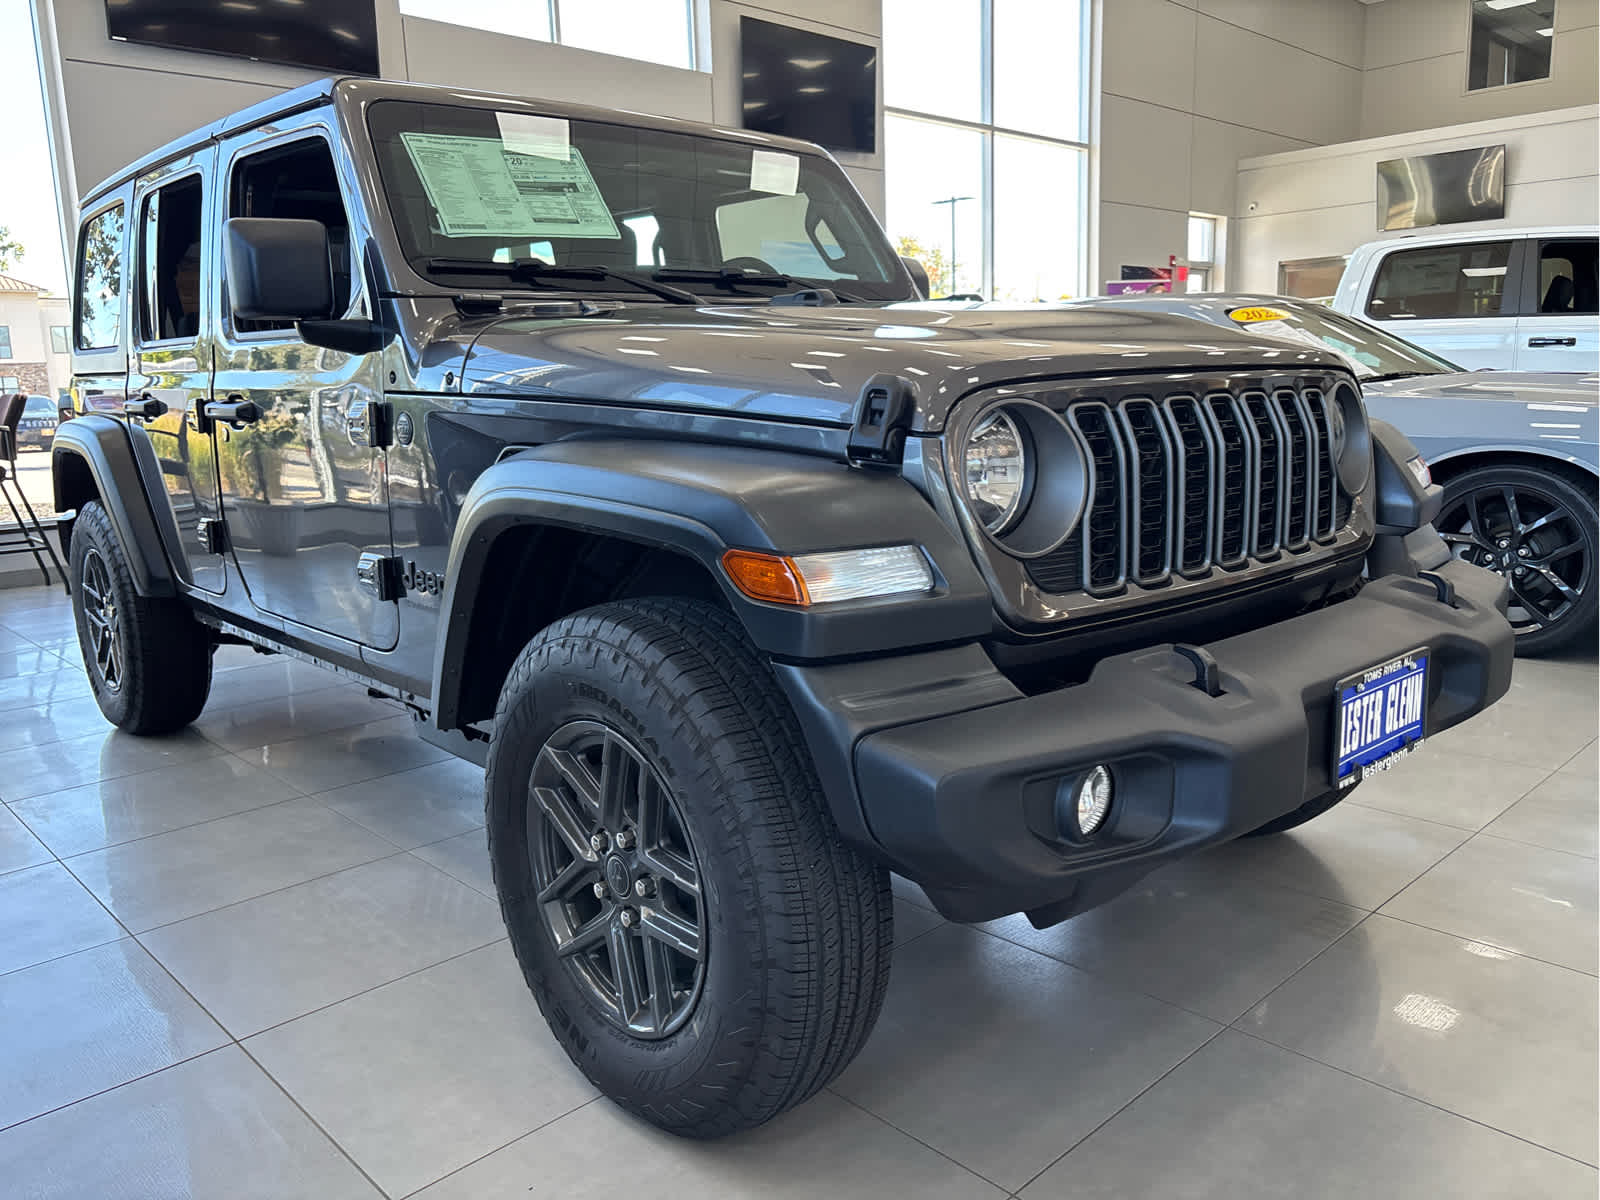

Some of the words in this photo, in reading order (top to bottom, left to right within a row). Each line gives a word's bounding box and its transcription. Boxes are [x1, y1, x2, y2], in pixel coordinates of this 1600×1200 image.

[1363, 668, 1383, 684] TOMS
[1339, 690, 1383, 758] LESTER
[1385, 672, 1423, 735] GLENN
